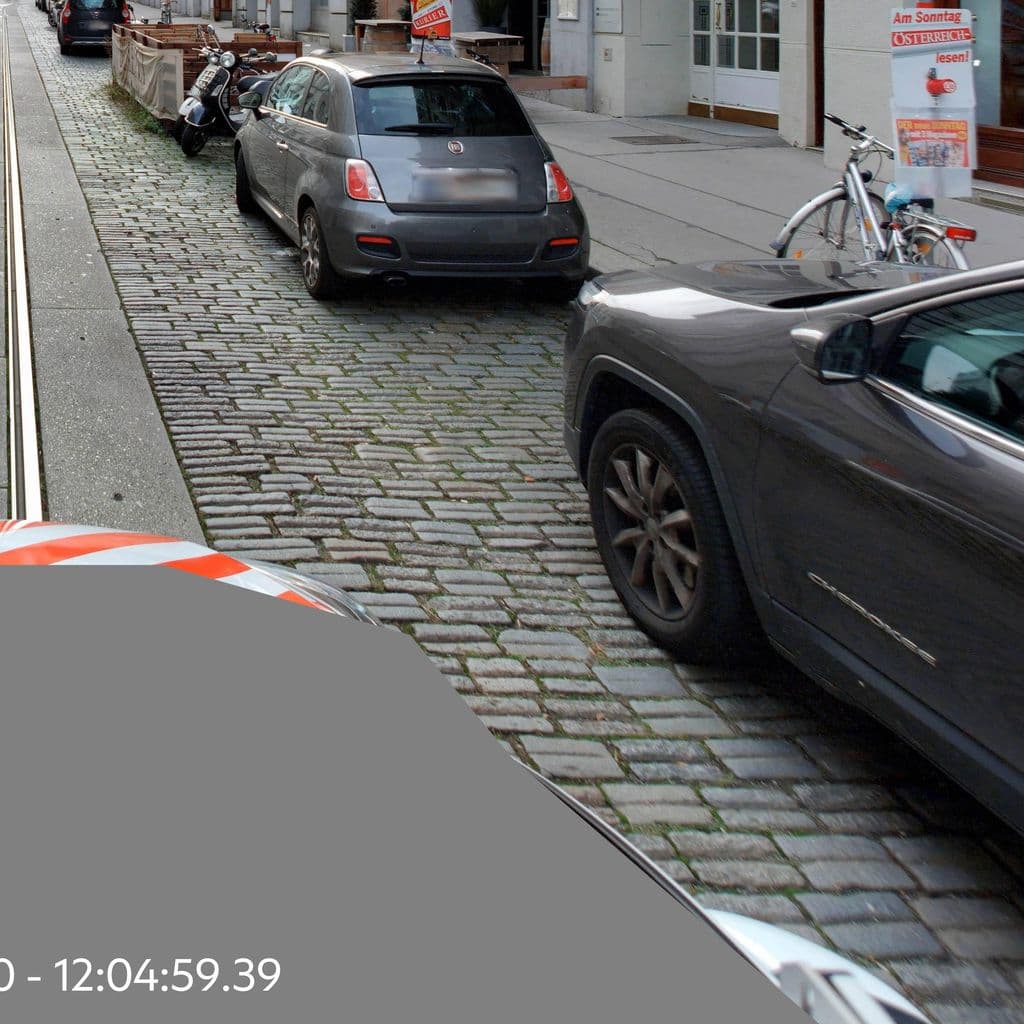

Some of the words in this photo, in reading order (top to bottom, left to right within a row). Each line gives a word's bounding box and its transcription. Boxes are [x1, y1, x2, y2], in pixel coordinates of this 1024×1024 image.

[415, 8, 447, 26] KURIER
[893, 12, 913, 24] Am
[915, 10, 962, 25] Sonntag
[936, 51, 969, 63] lesen!
